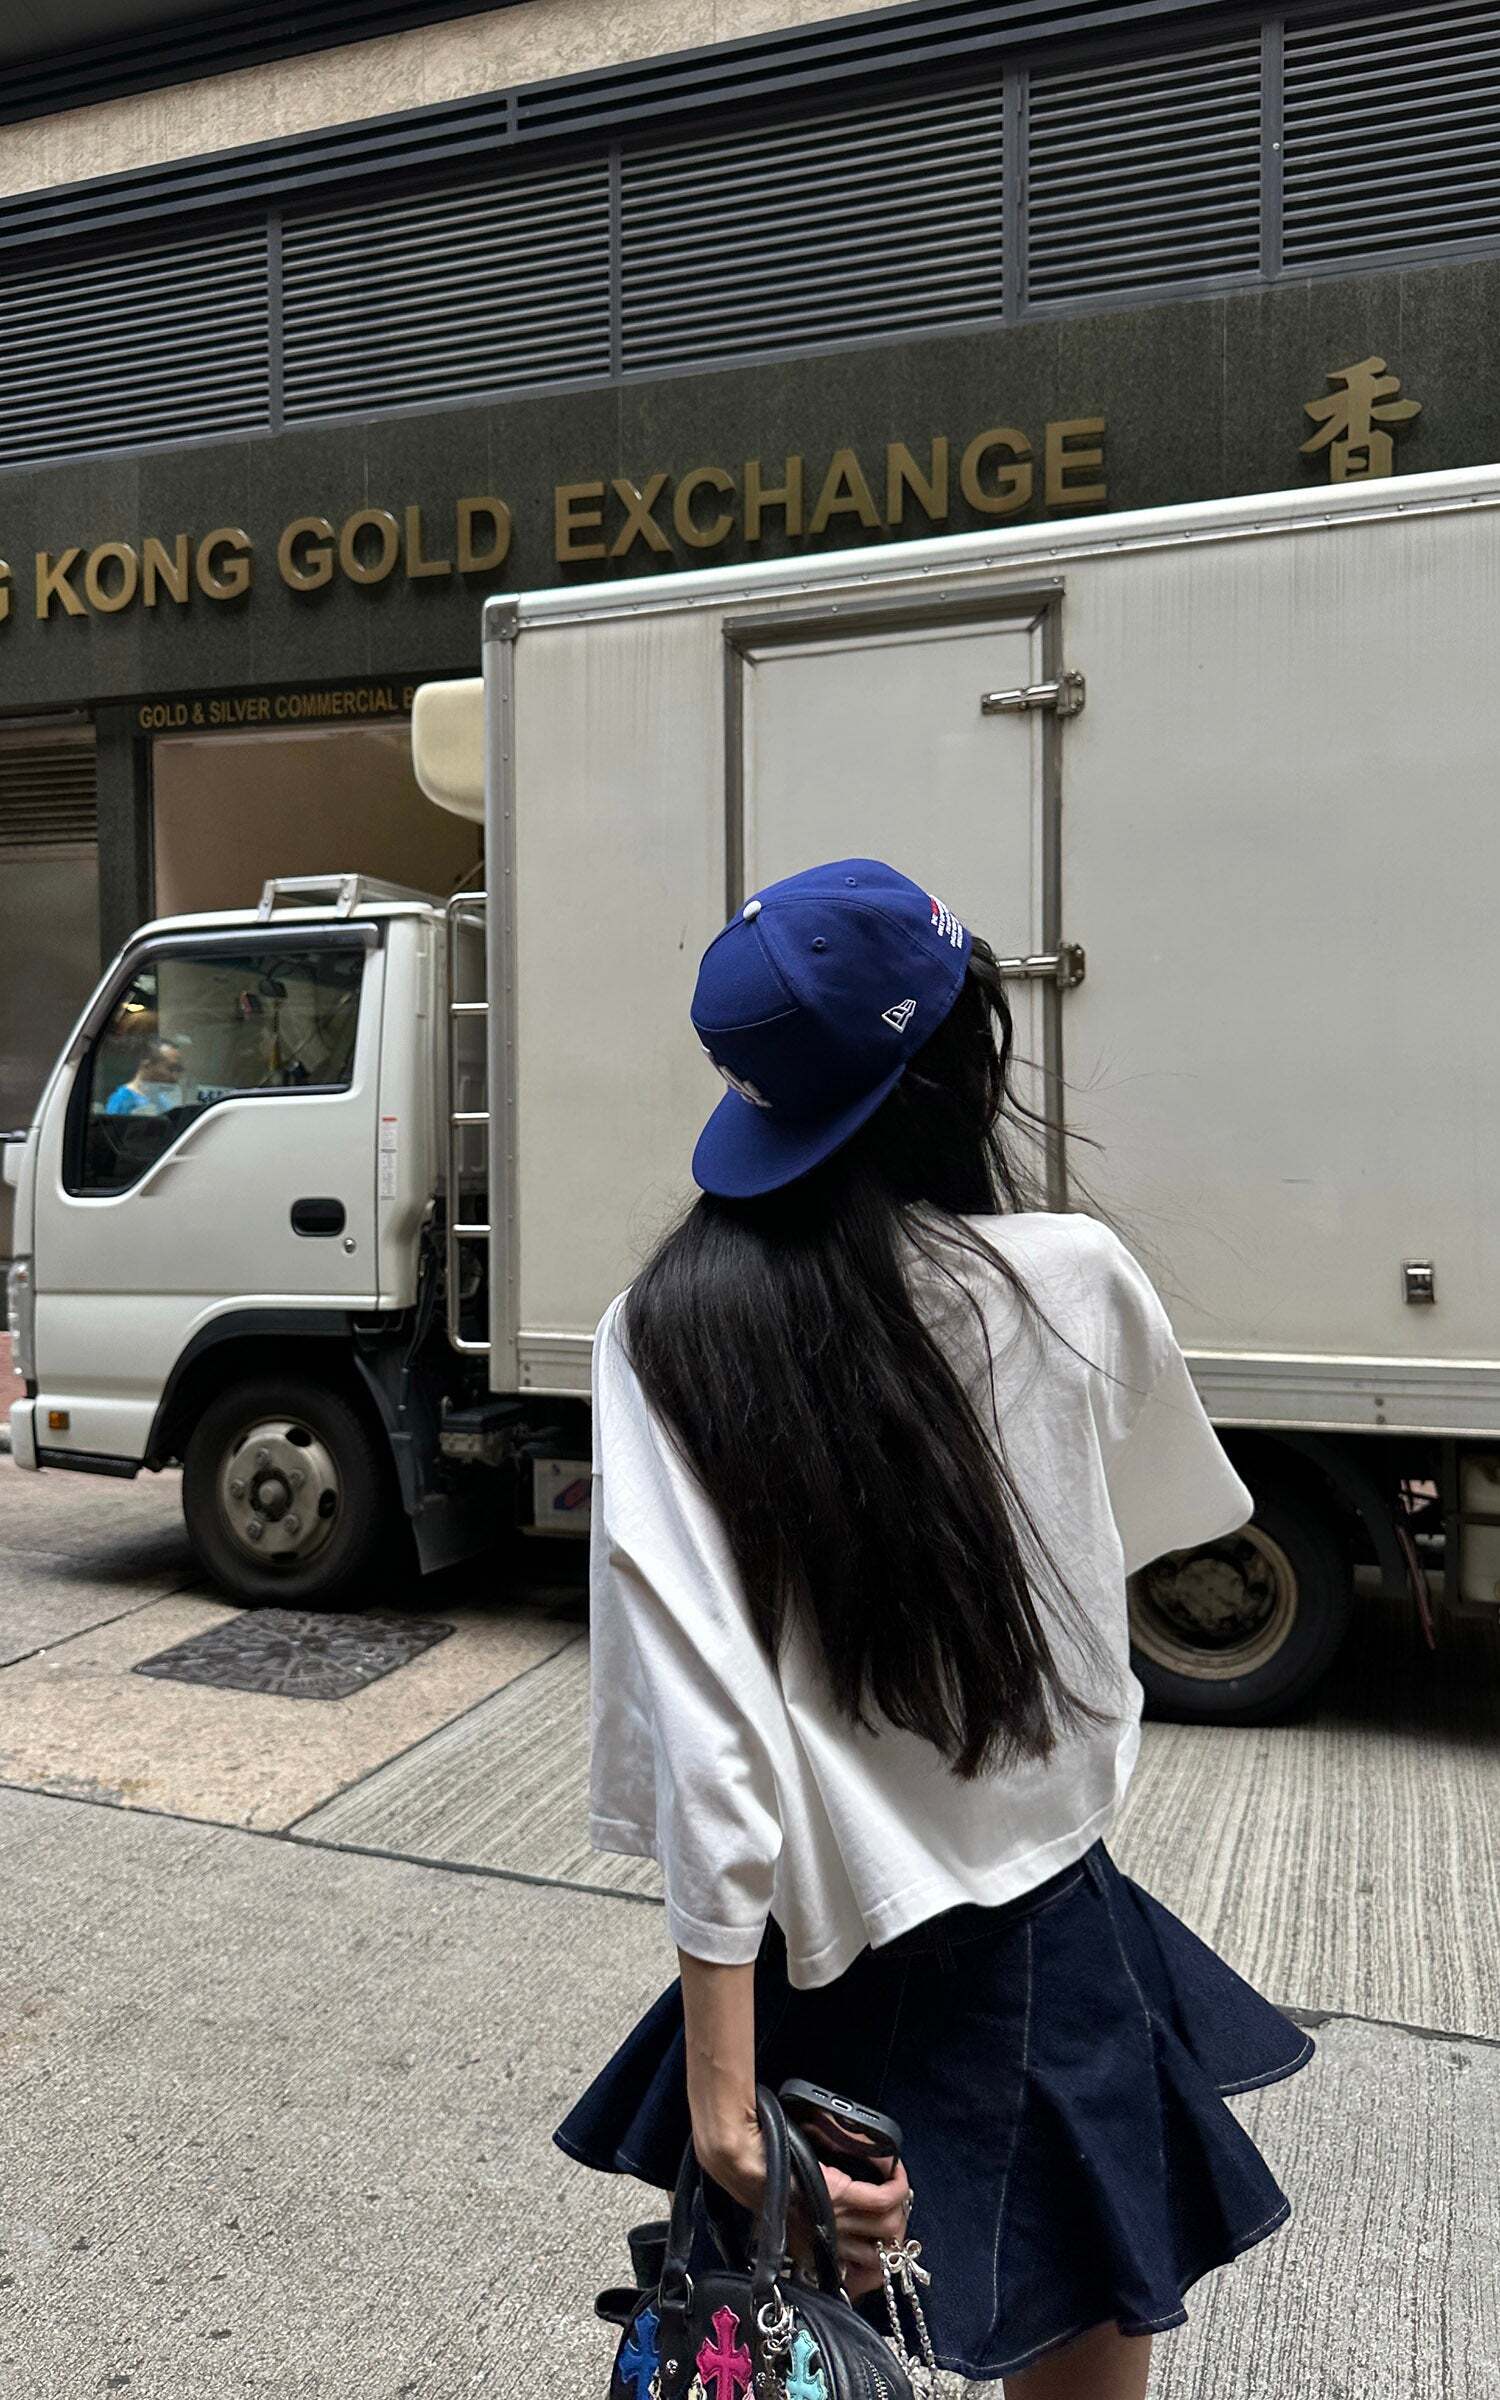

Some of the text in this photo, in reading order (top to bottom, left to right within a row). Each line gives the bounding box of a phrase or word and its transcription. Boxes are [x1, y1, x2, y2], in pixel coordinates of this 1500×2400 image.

[1299, 355, 1423, 484] 香
[36, 527, 253, 620] KONG
[277, 497, 512, 592] GOLD
[554, 417, 1107, 563] EXCHANGE
[139, 704, 188, 729] GOLD
[192, 702, 205, 724] &
[209, 698, 271, 723] SILVER
[275, 688, 399, 718] COMMERCIAL
